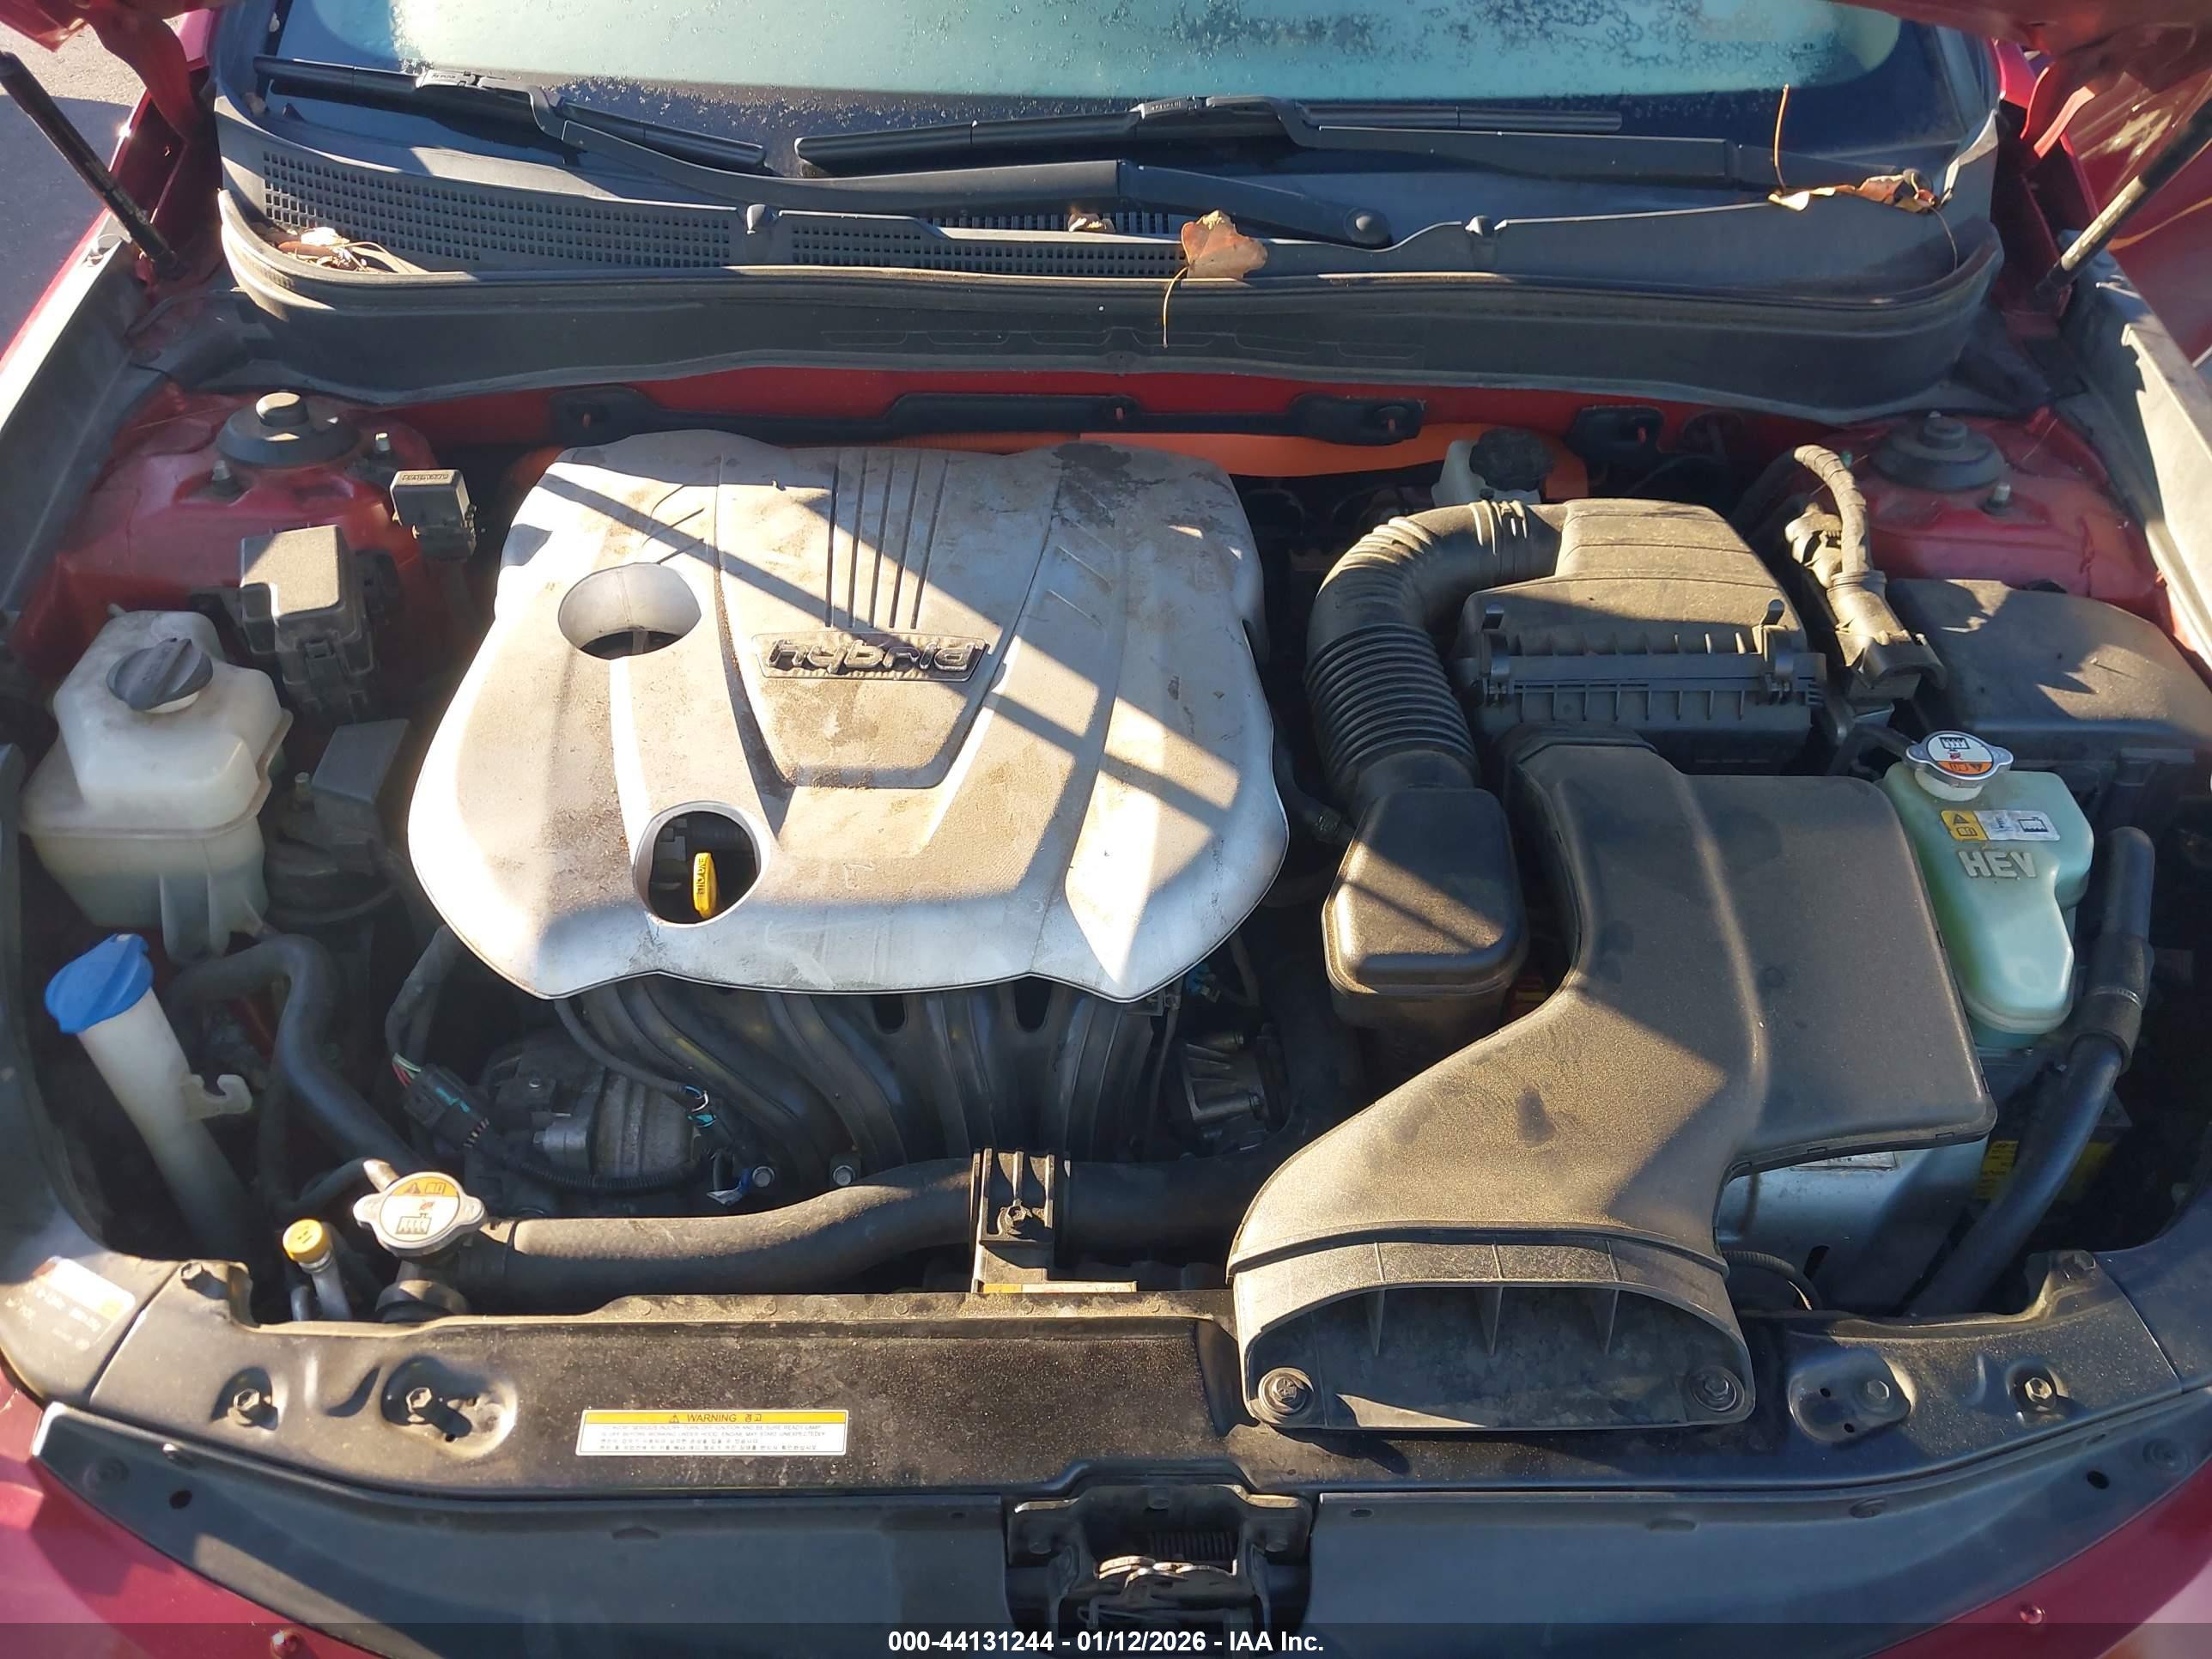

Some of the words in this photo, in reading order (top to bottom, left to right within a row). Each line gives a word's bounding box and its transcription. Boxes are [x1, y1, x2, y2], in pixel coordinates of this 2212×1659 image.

[767, 638, 978, 674] hybrid
[1958, 851, 2037, 878] HEV
[686, 1413, 737, 1423] WARNING
[744, 1413, 762, 1423] 경고
